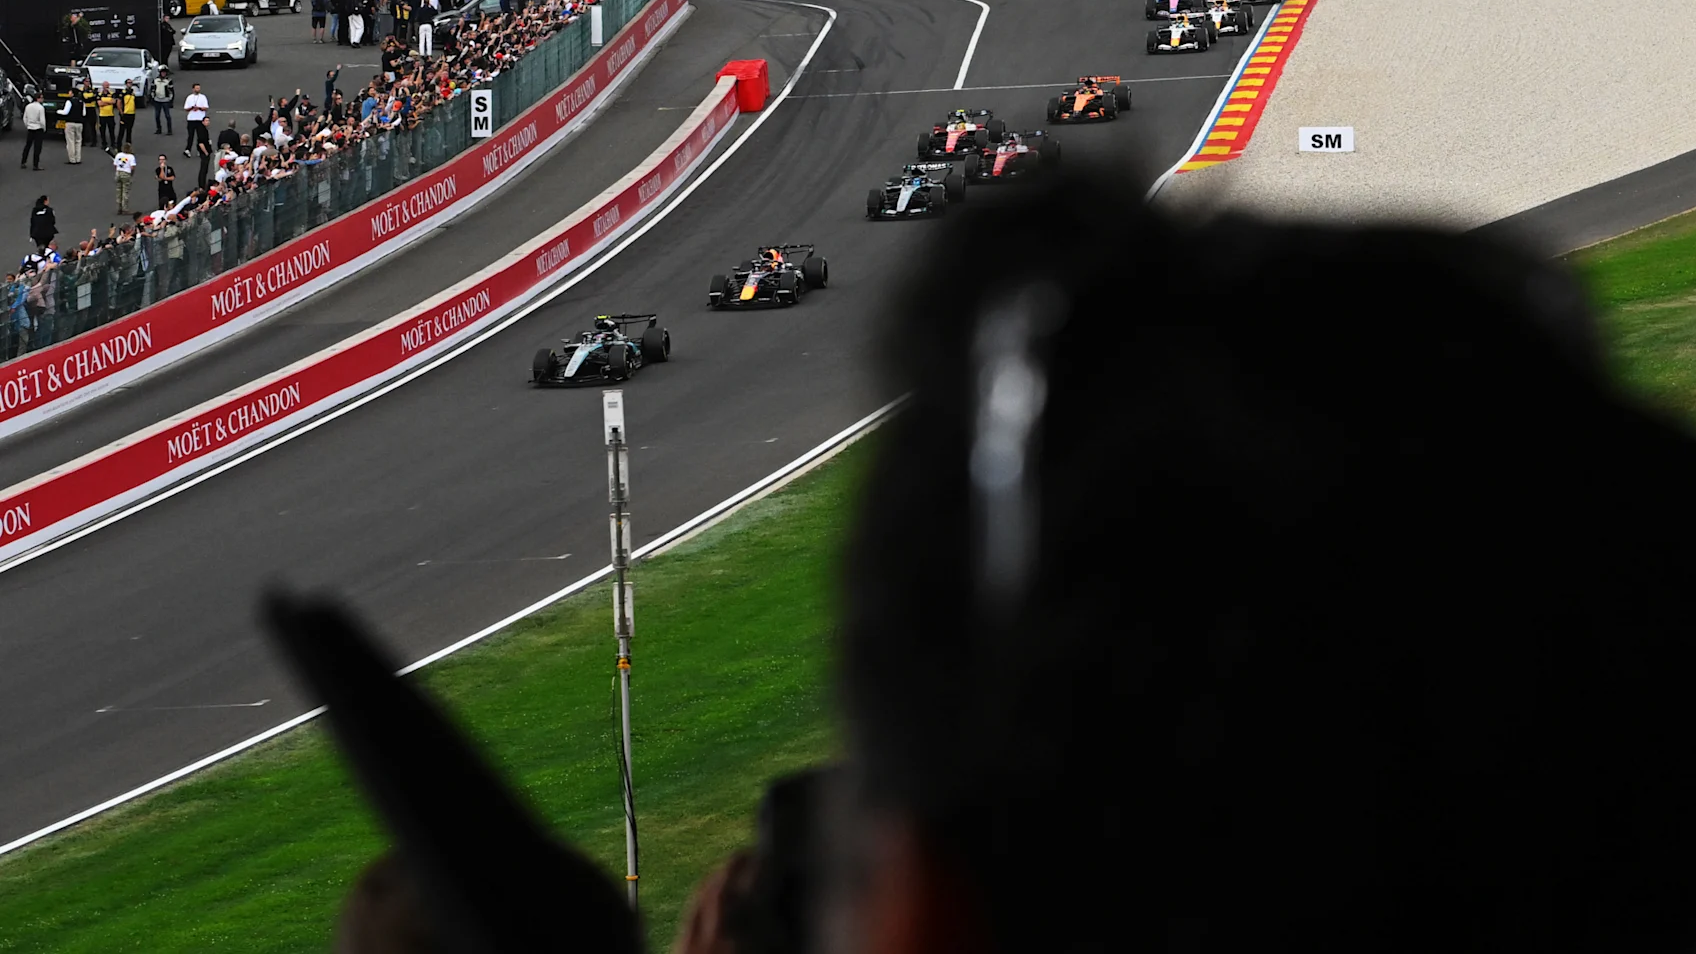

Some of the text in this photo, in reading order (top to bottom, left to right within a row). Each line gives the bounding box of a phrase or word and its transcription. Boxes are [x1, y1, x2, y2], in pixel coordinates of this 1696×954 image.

[482, 120, 538, 178] MOËT & CHANDON
[1311, 133, 1342, 149] SM
[371, 203, 401, 241] MOËT
[402, 200, 411, 224] &
[410, 174, 457, 218] CHANDON
[211, 276, 253, 320] MOËT
[255, 273, 267, 299] &
[267, 240, 331, 293] CHANDON
[400, 288, 491, 355] MOËT & CHANDON
[47, 363, 62, 393] &
[63, 322, 152, 385] CHANDON
[167, 421, 212, 464] MOËT
[215, 417, 228, 442] &
[228, 382, 301, 435] CHANDON
